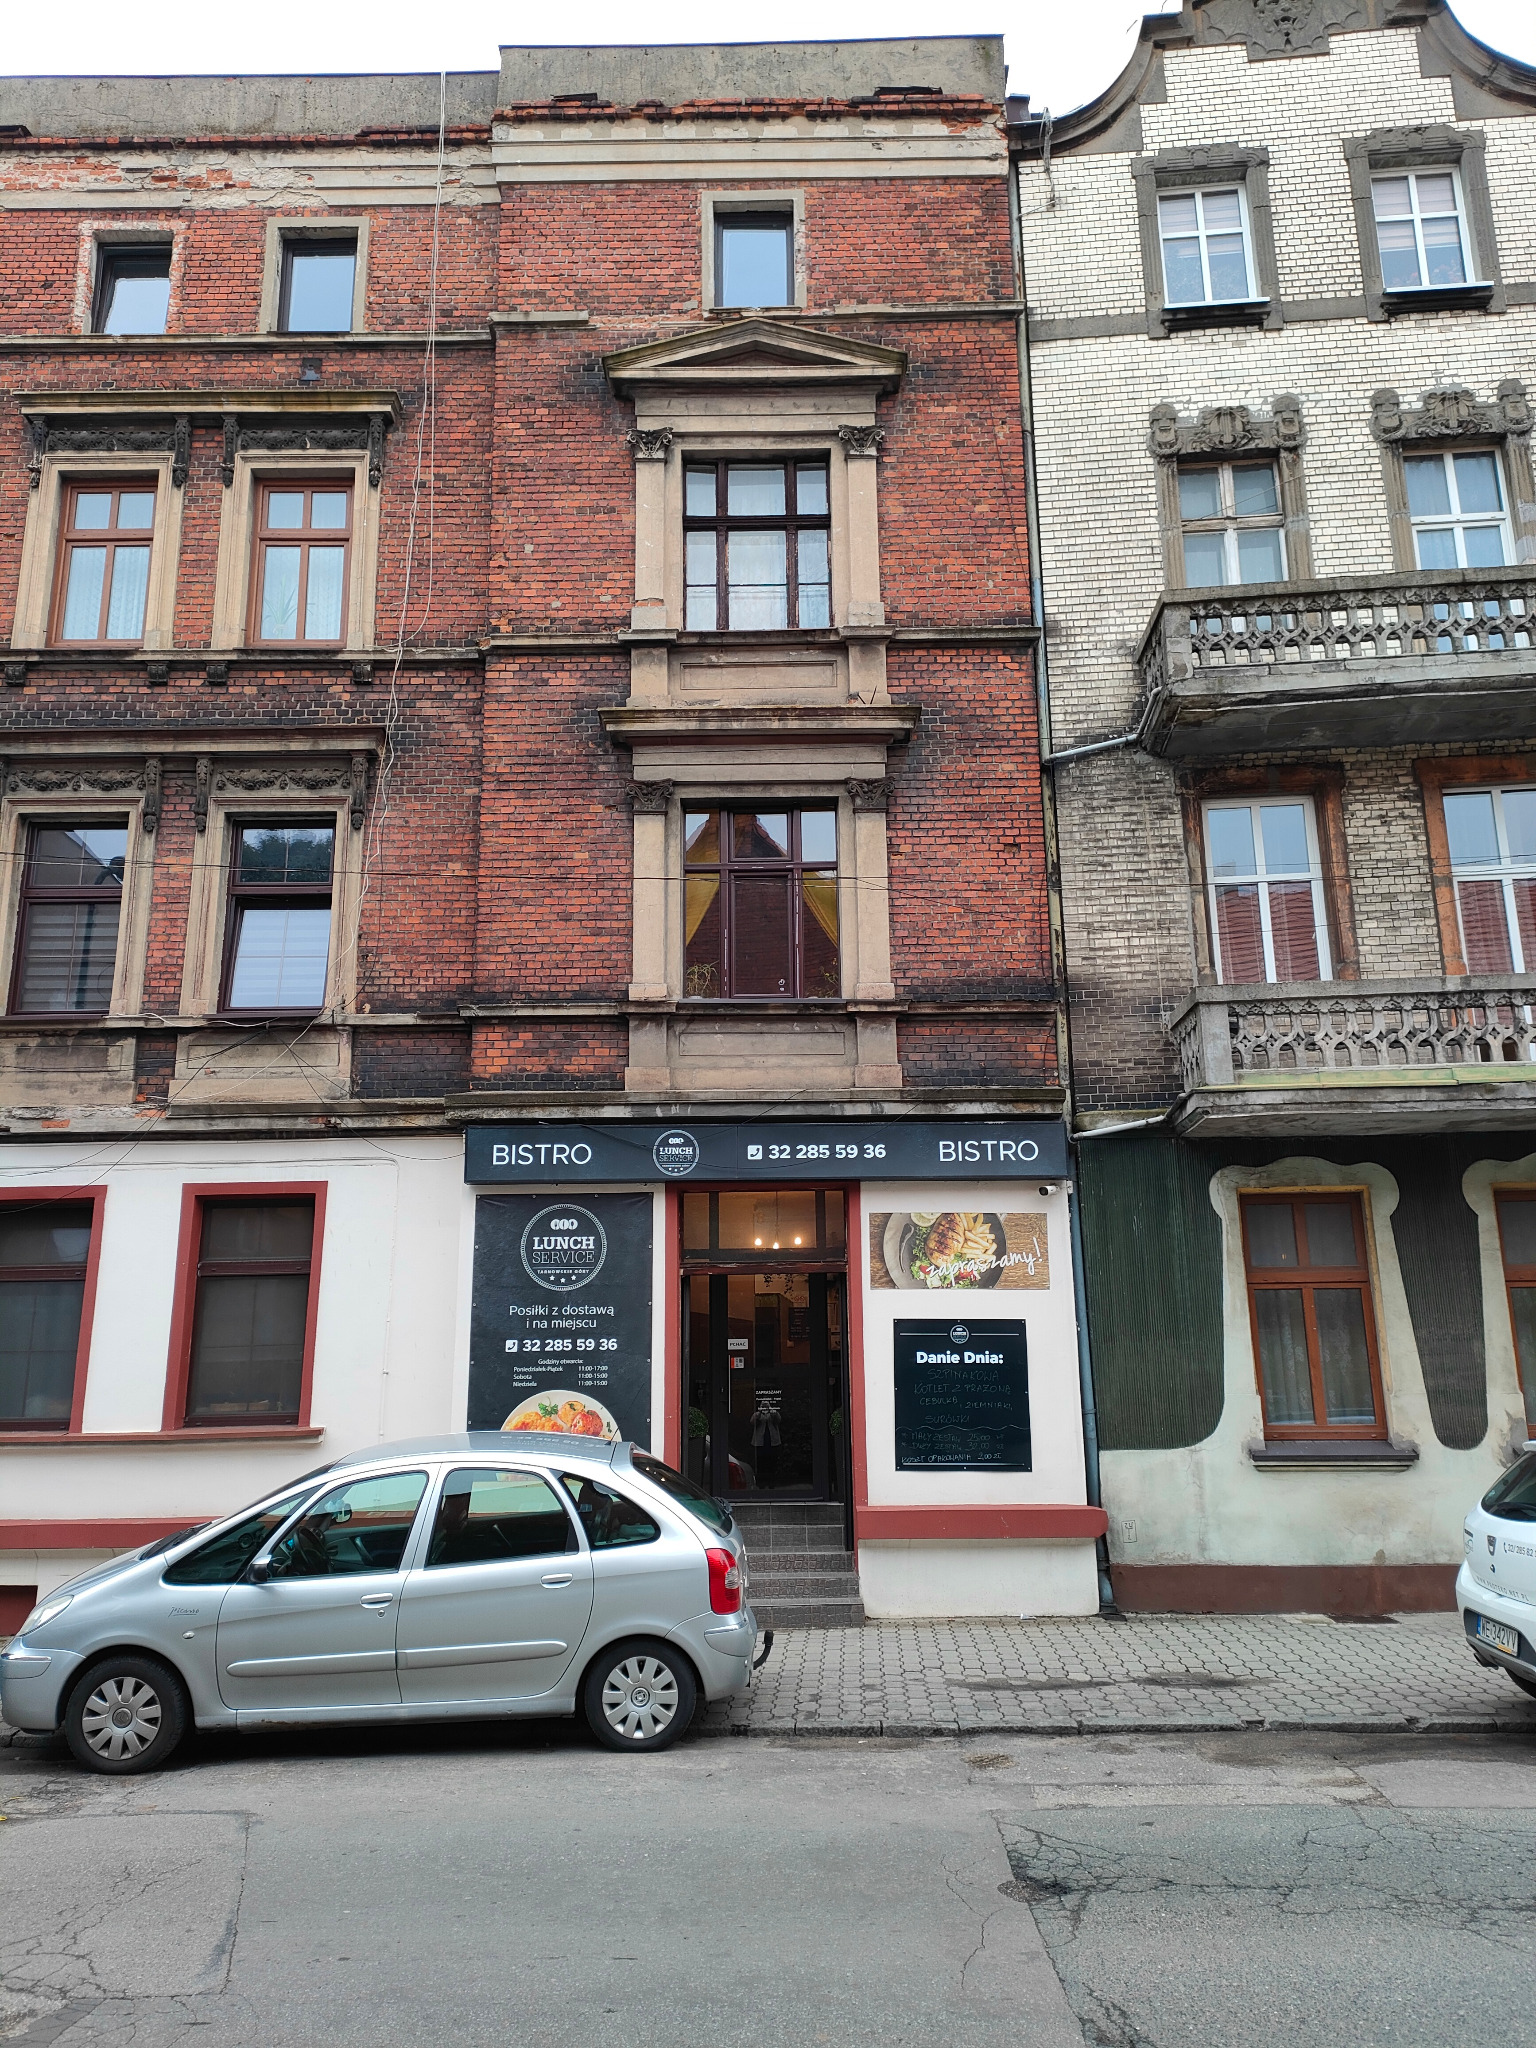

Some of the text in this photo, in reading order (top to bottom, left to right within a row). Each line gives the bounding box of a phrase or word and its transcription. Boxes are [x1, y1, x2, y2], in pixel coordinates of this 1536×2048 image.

[491, 1143, 593, 1166] BISTRO
[659, 1147, 694, 1155] LUNCH
[768, 1144, 887, 1160] 32 285 59 36
[938, 1140, 1040, 1163] BISTRO
[659, 1154, 693, 1162] SERVICE
[532, 1236, 595, 1250] LUNCH
[532, 1250, 595, 1264] SERVICE
[925, 1236, 1043, 1288] zapraszamy!
[509, 1304, 615, 1318] Posiłki z dostawą
[526, 1318, 597, 1331] i na miejscu
[522, 1339, 618, 1352] 32 285 59 36
[537, 1358, 560, 1366] Godziny
[916, 1351, 1004, 1365] Danie Dnia:
[927, 1368, 1000, 1381] SZPINAKOWA
[913, 1382, 951, 1395] KOTLET
[924, 1414, 970, 1424] SURÓWKI
[168, 1606, 200, 1618] Picasso
[1481, 1617, 1517, 1650] WE 342VV
